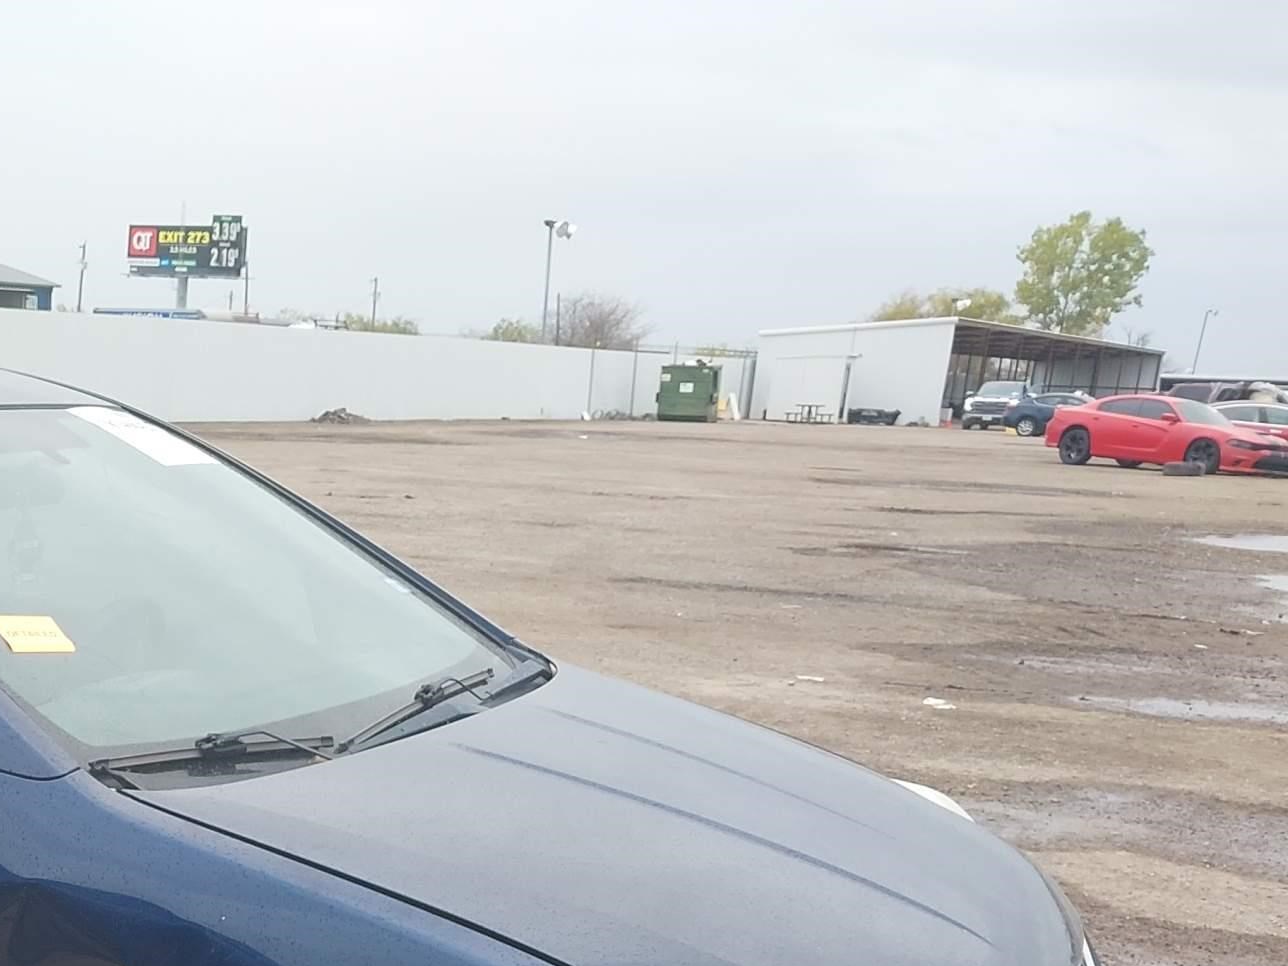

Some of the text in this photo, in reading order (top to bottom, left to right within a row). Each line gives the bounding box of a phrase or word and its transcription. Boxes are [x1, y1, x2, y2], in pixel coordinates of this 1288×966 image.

[132, 231, 153, 251] QT
[158, 230, 211, 244] EXIT 273
